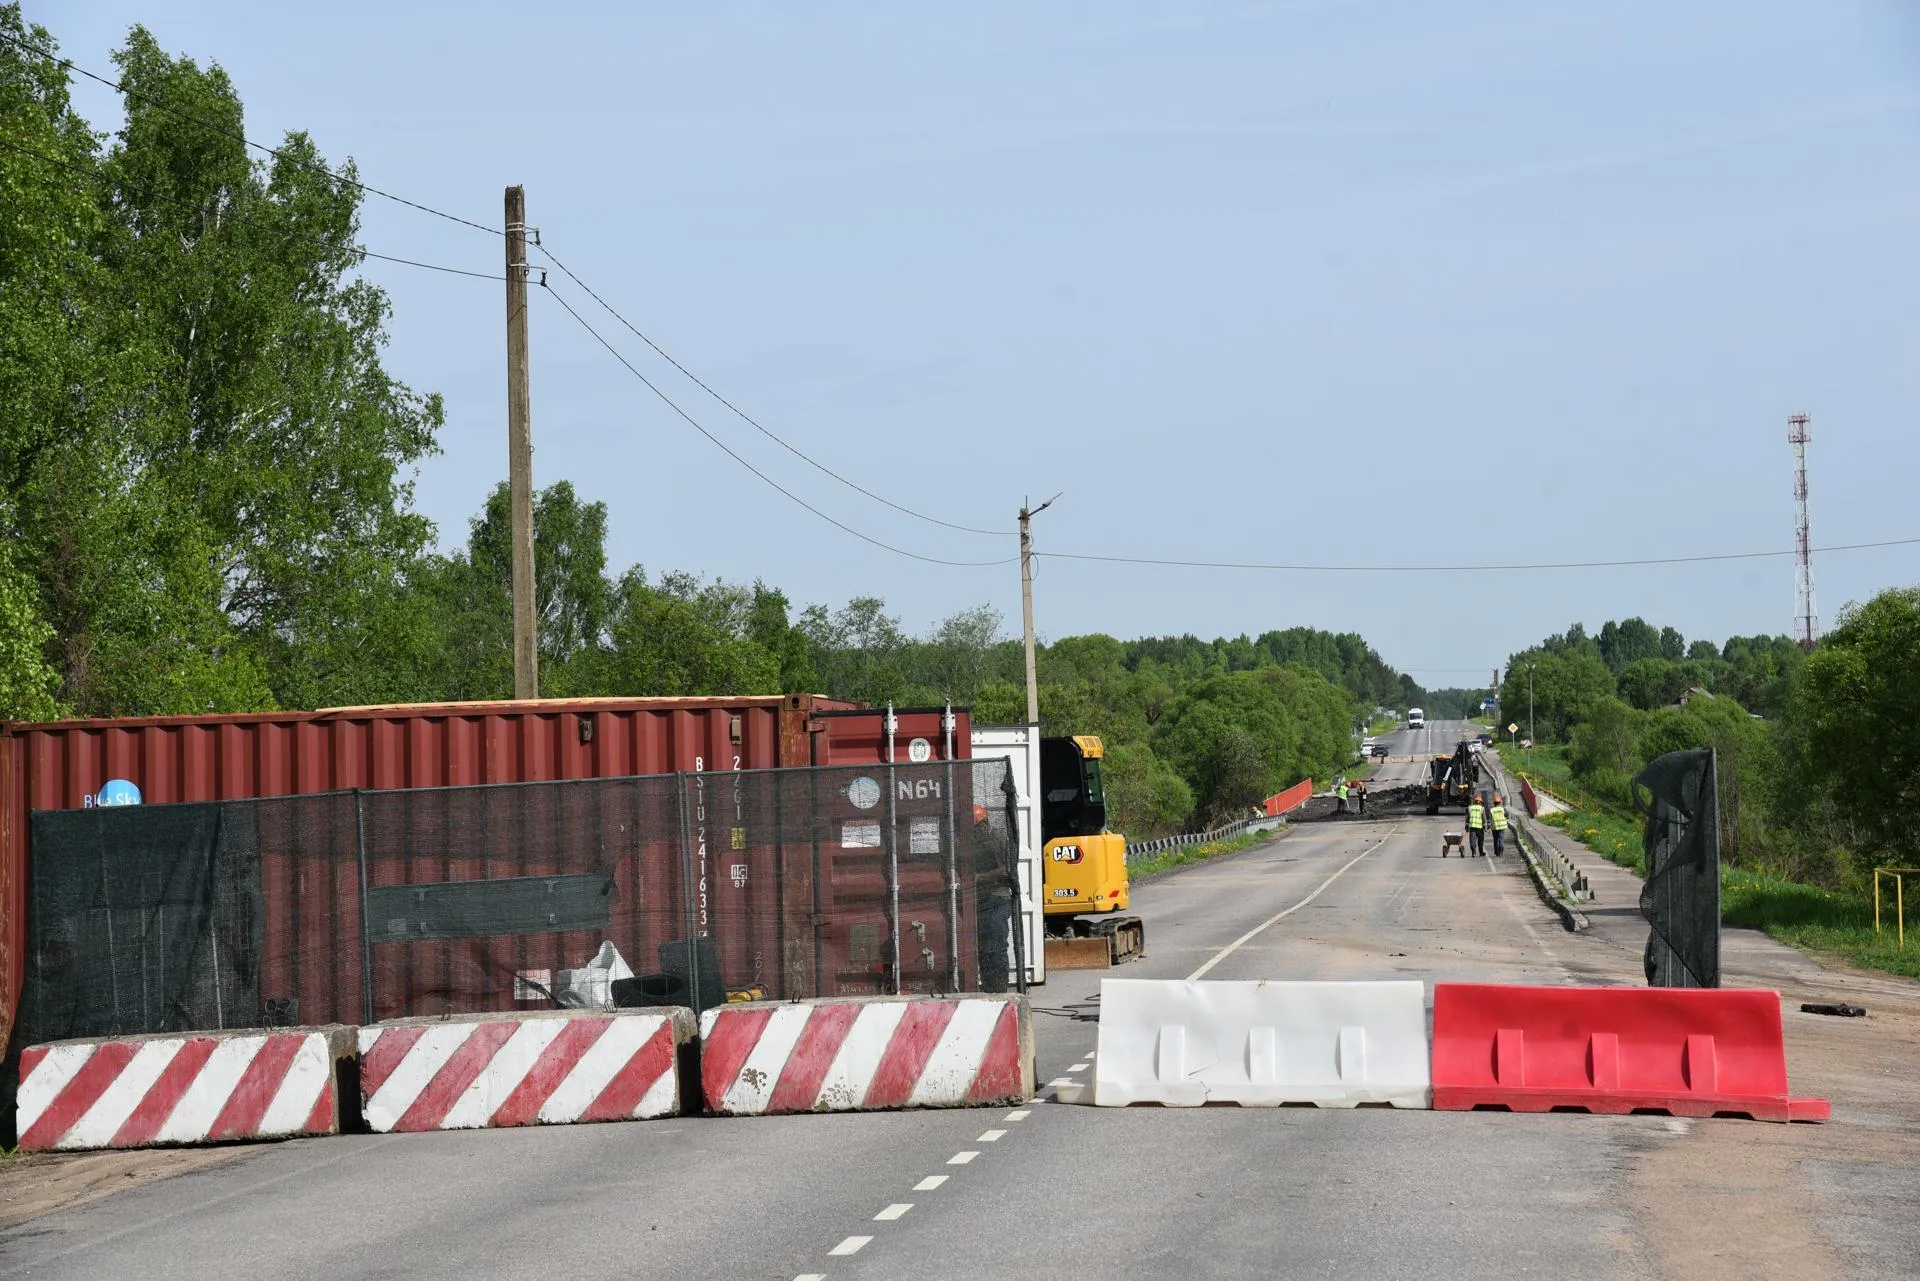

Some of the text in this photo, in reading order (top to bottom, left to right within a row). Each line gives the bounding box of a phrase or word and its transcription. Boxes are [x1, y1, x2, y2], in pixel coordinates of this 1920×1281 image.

[898, 779, 941, 800] N64
[84, 792, 142, 808] Blue Sky
[1054, 846, 1077, 861] CAT
[734, 879, 745, 888] 87
[1054, 889, 1075, 897] 303.5
